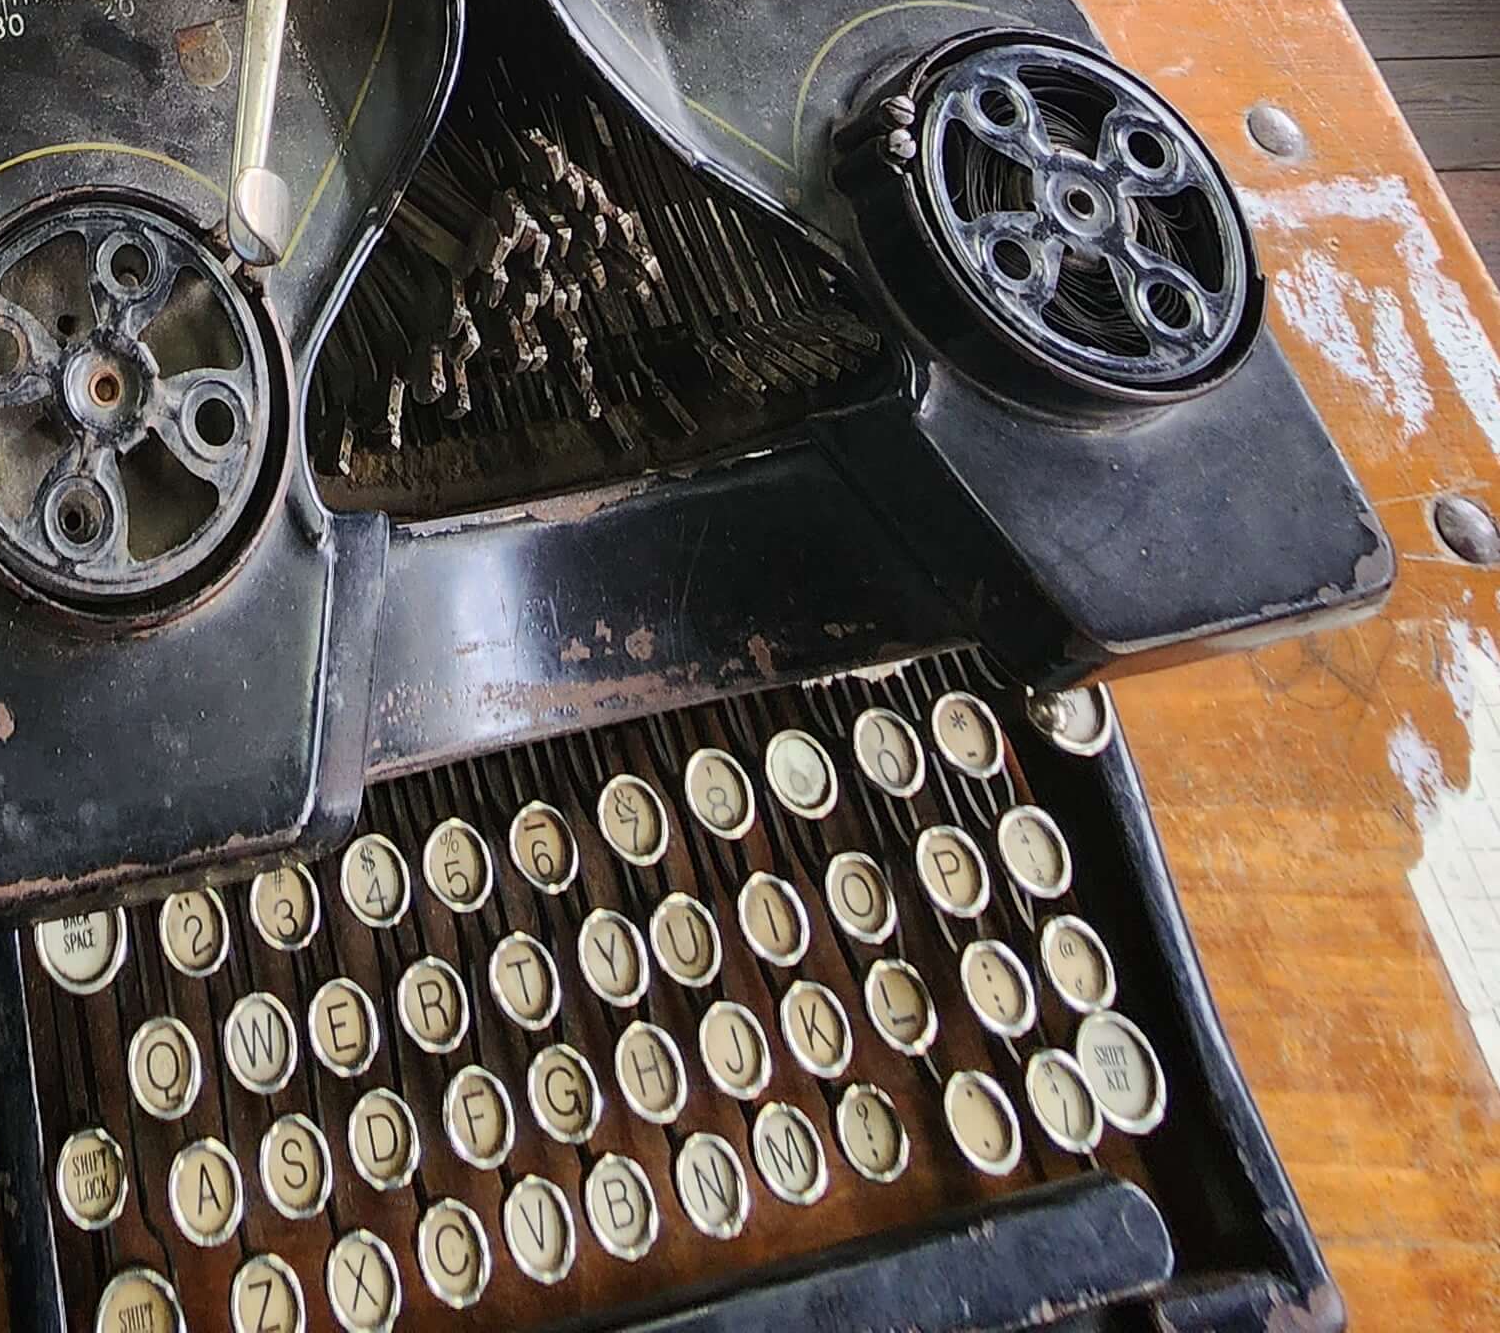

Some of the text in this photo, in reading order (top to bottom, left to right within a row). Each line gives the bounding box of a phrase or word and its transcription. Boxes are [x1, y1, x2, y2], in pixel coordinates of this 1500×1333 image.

[706, 786, 736, 826] 8
[619, 816, 640, 851] 7
[443, 860, 470, 900] 5
[531, 840, 555, 879] 6
[932, 849, 961, 898] P
[274, 898, 299, 939] 3
[365, 876, 388, 915] 4
[840, 871, 874, 918] O
[63, 929, 97, 955] SPACE
[183, 914, 213, 959] 2
[593, 932, 618, 983] Y
[666, 915, 700, 966] U
[416, 979, 449, 1031] R
[506, 957, 532, 1006] T
[879, 979, 918, 1028] L
[236, 1011, 275, 1069] W
[326, 1000, 358, 1053] E
[724, 1023, 744, 1075] J
[798, 1001, 834, 1052] K
[146, 1040, 183, 1103] Q
[630, 1042, 666, 1098] H
[1092, 1043, 1130, 1067] SHIFT
[544, 1065, 585, 1117] G
[1104, 1069, 1134, 1093] KEY
[366, 1112, 399, 1163] D
[461, 1088, 485, 1145] F
[71, 1146, 109, 1179] SHIFT
[280, 1137, 308, 1190] S
[764, 1124, 809, 1183] M
[75, 1173, 112, 1206] LOCK
[198, 1162, 222, 1216] A
[602, 1177, 635, 1230] B
[692, 1156, 729, 1212] N
[434, 1223, 470, 1277] C
[518, 1198, 546, 1252] V
[247, 1277, 281, 1333] Z
[343, 1253, 380, 1313] X
[117, 1301, 155, 1333] SHIFT
